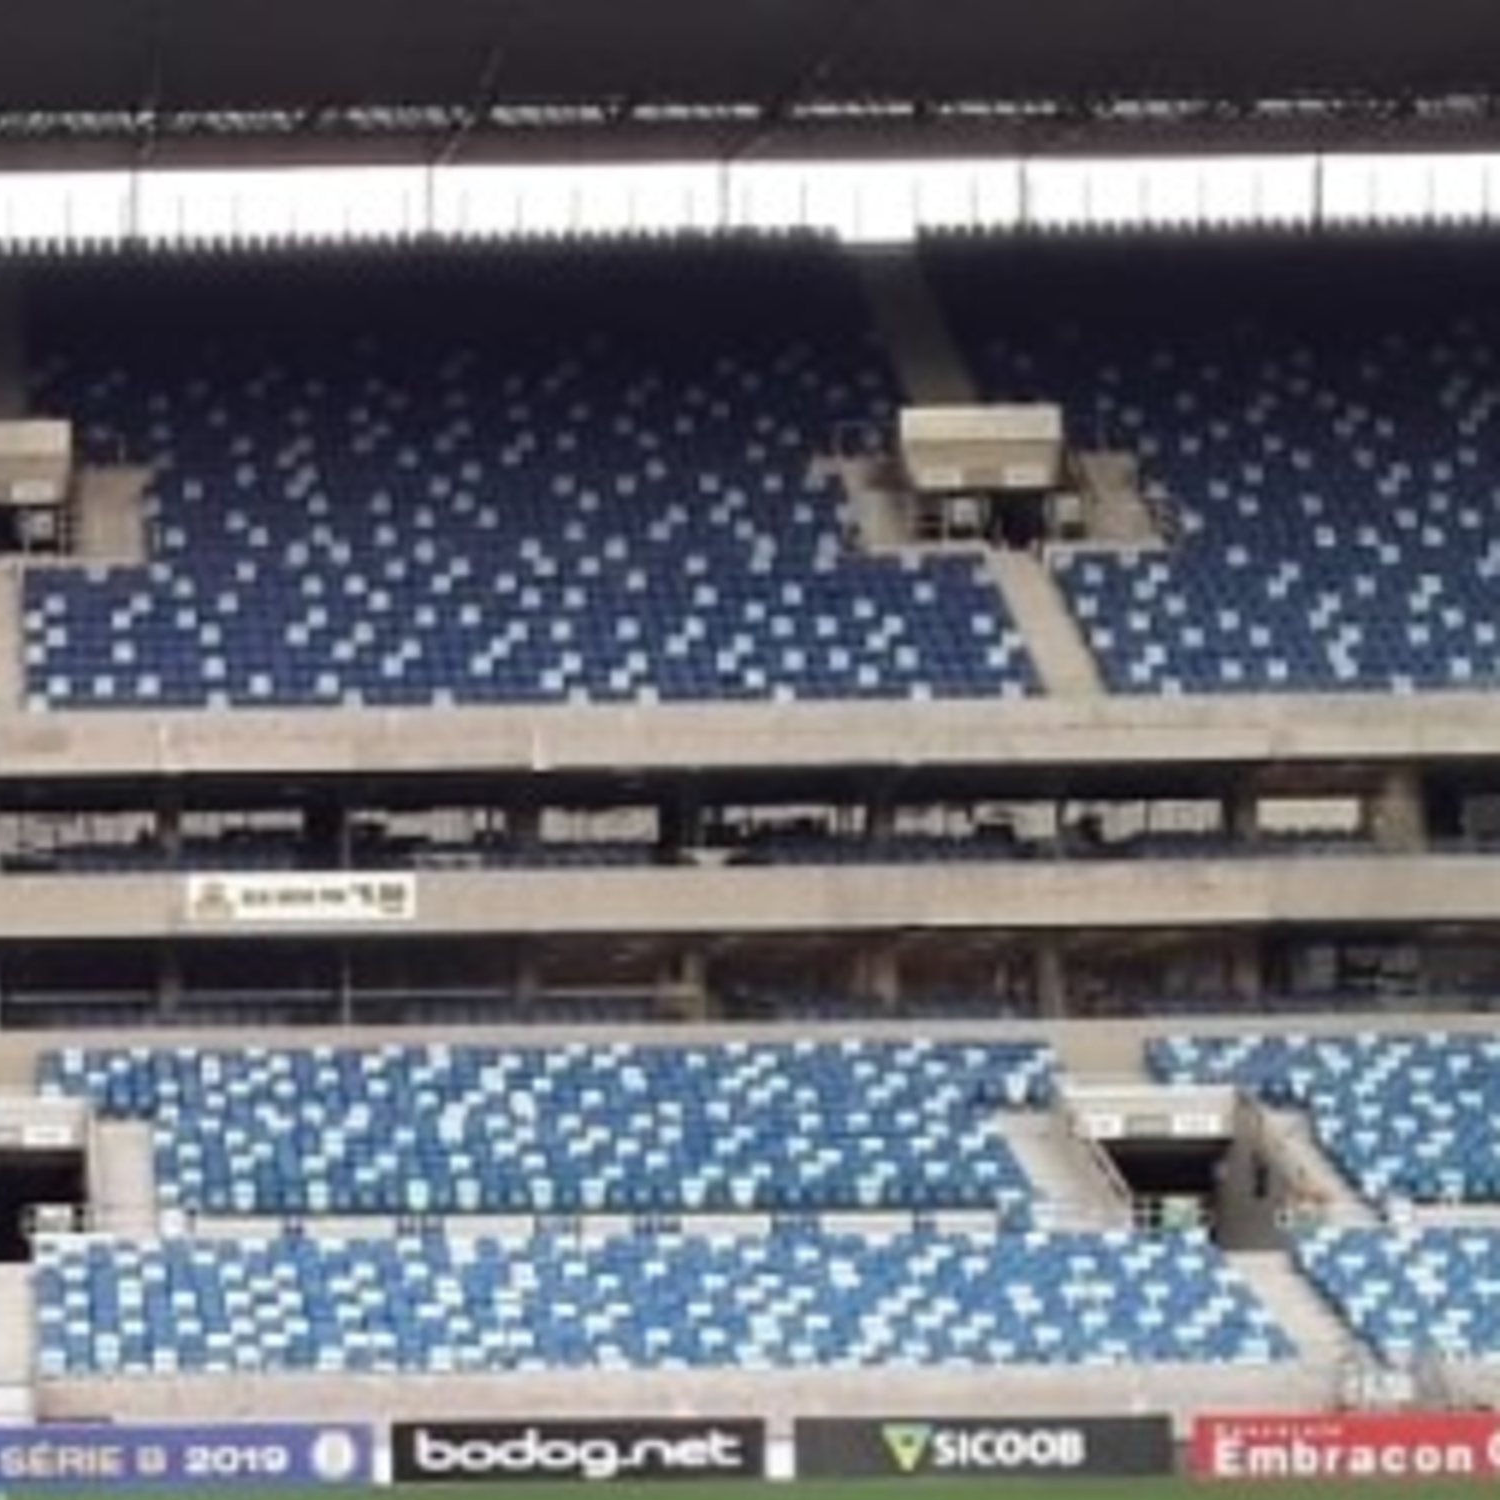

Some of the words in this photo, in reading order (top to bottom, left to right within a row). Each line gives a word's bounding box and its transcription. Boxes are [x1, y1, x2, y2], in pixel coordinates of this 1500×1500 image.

[0, 1440, 124, 1477] SÉRIE
[183, 1444, 290, 1474] 2019
[414, 1427, 744, 1478] bodog.net
[932, 1428, 1086, 1467] SICOOB
[1213, 1438, 1474, 1476] Embracon
